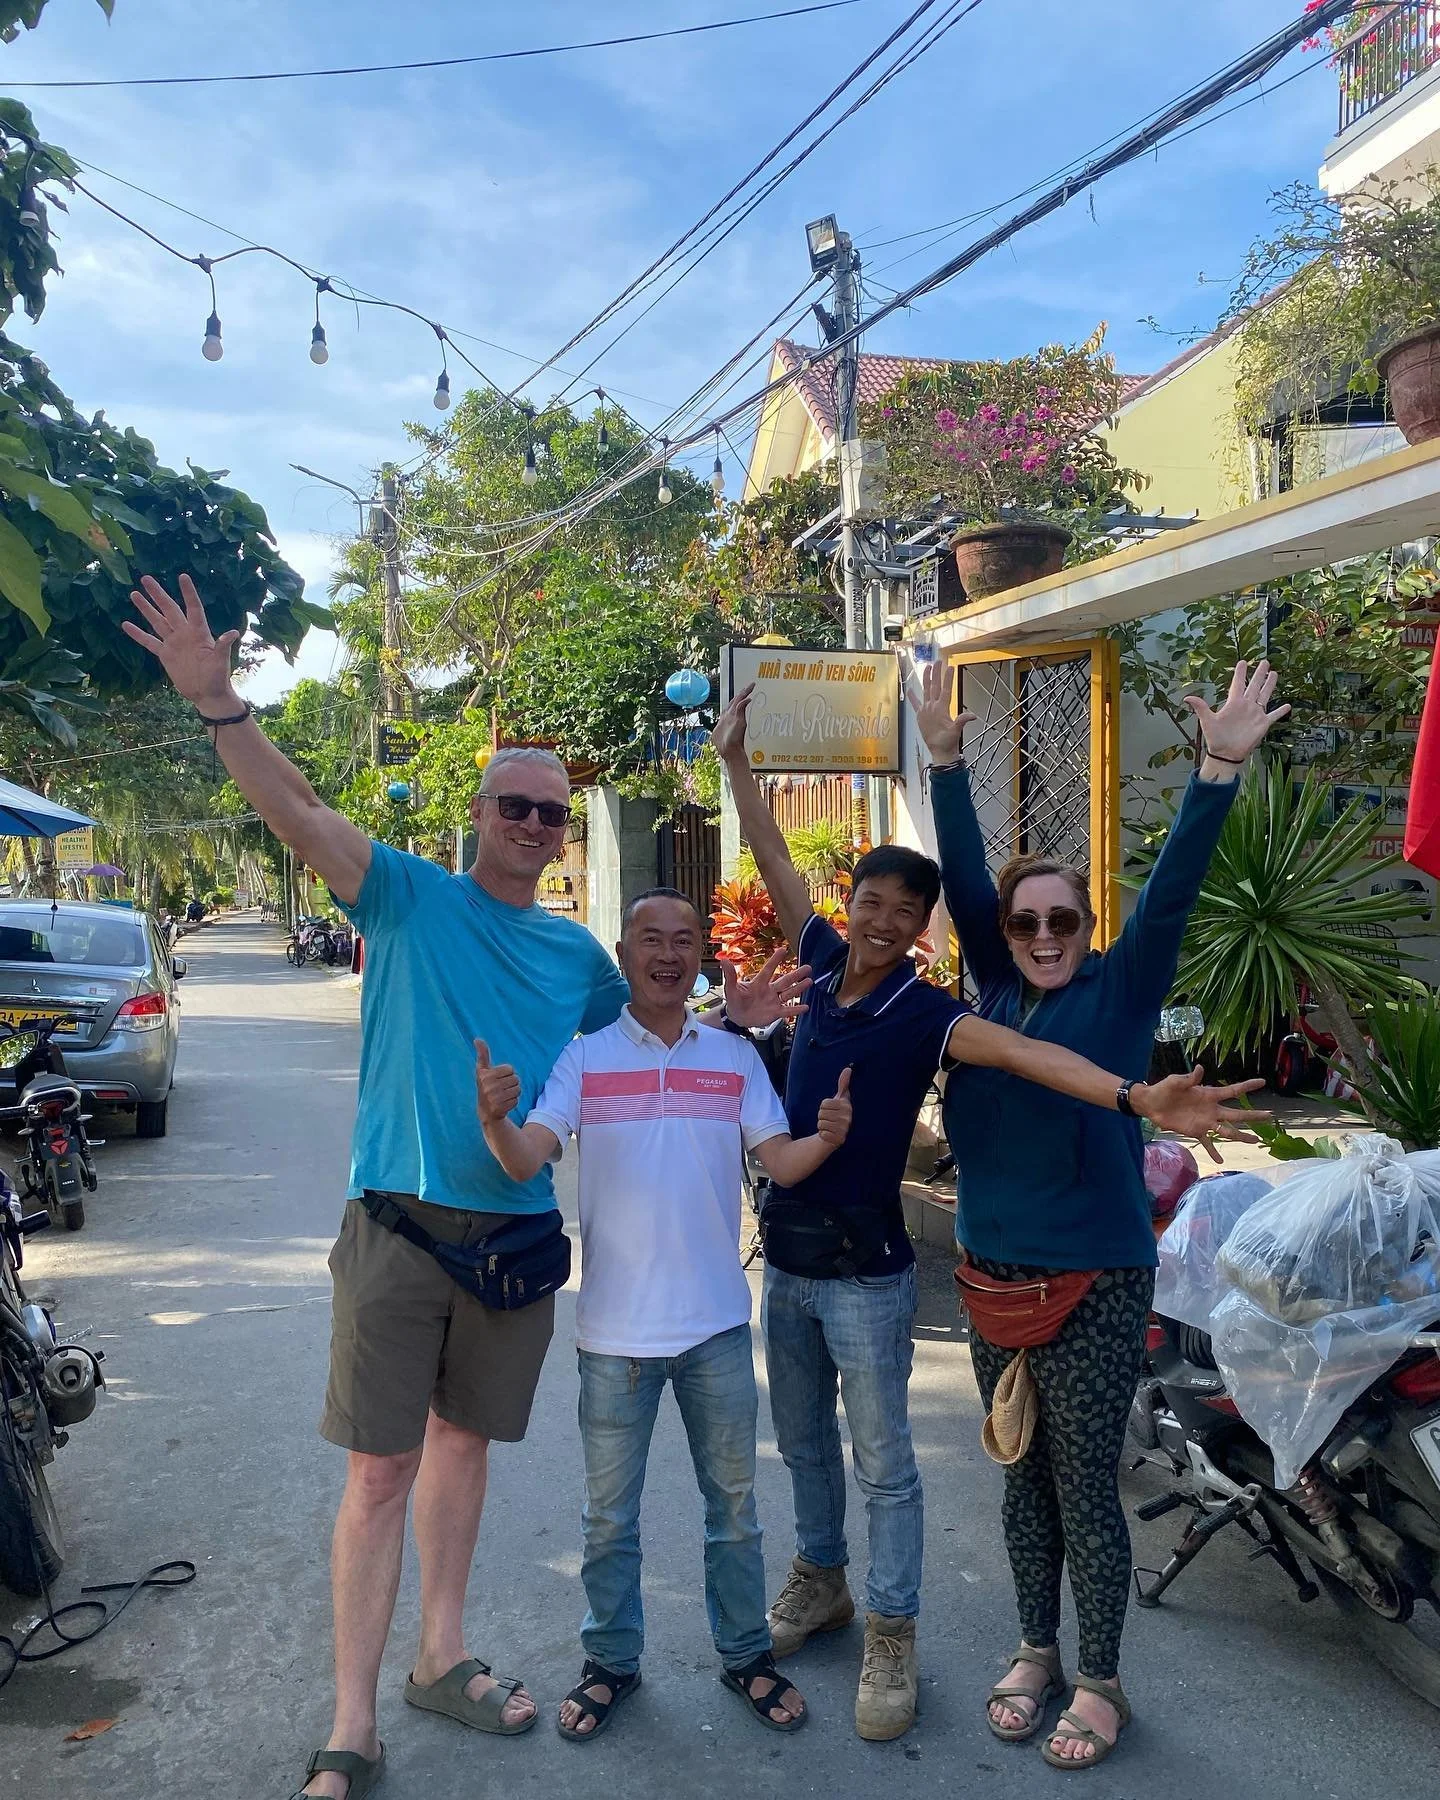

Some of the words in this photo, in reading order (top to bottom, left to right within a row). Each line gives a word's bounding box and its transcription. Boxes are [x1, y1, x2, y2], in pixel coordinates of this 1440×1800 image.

[758, 658, 781, 680] NHÀ
[783, 662, 806, 681] SAN
[825, 664, 847, 682] VEN
[847, 661, 877, 683] SÔNG
[748, 691, 799, 740] Coral
[800, 693, 891, 744] Riverside
[696, 1078, 728, 1086] PEGASUS
